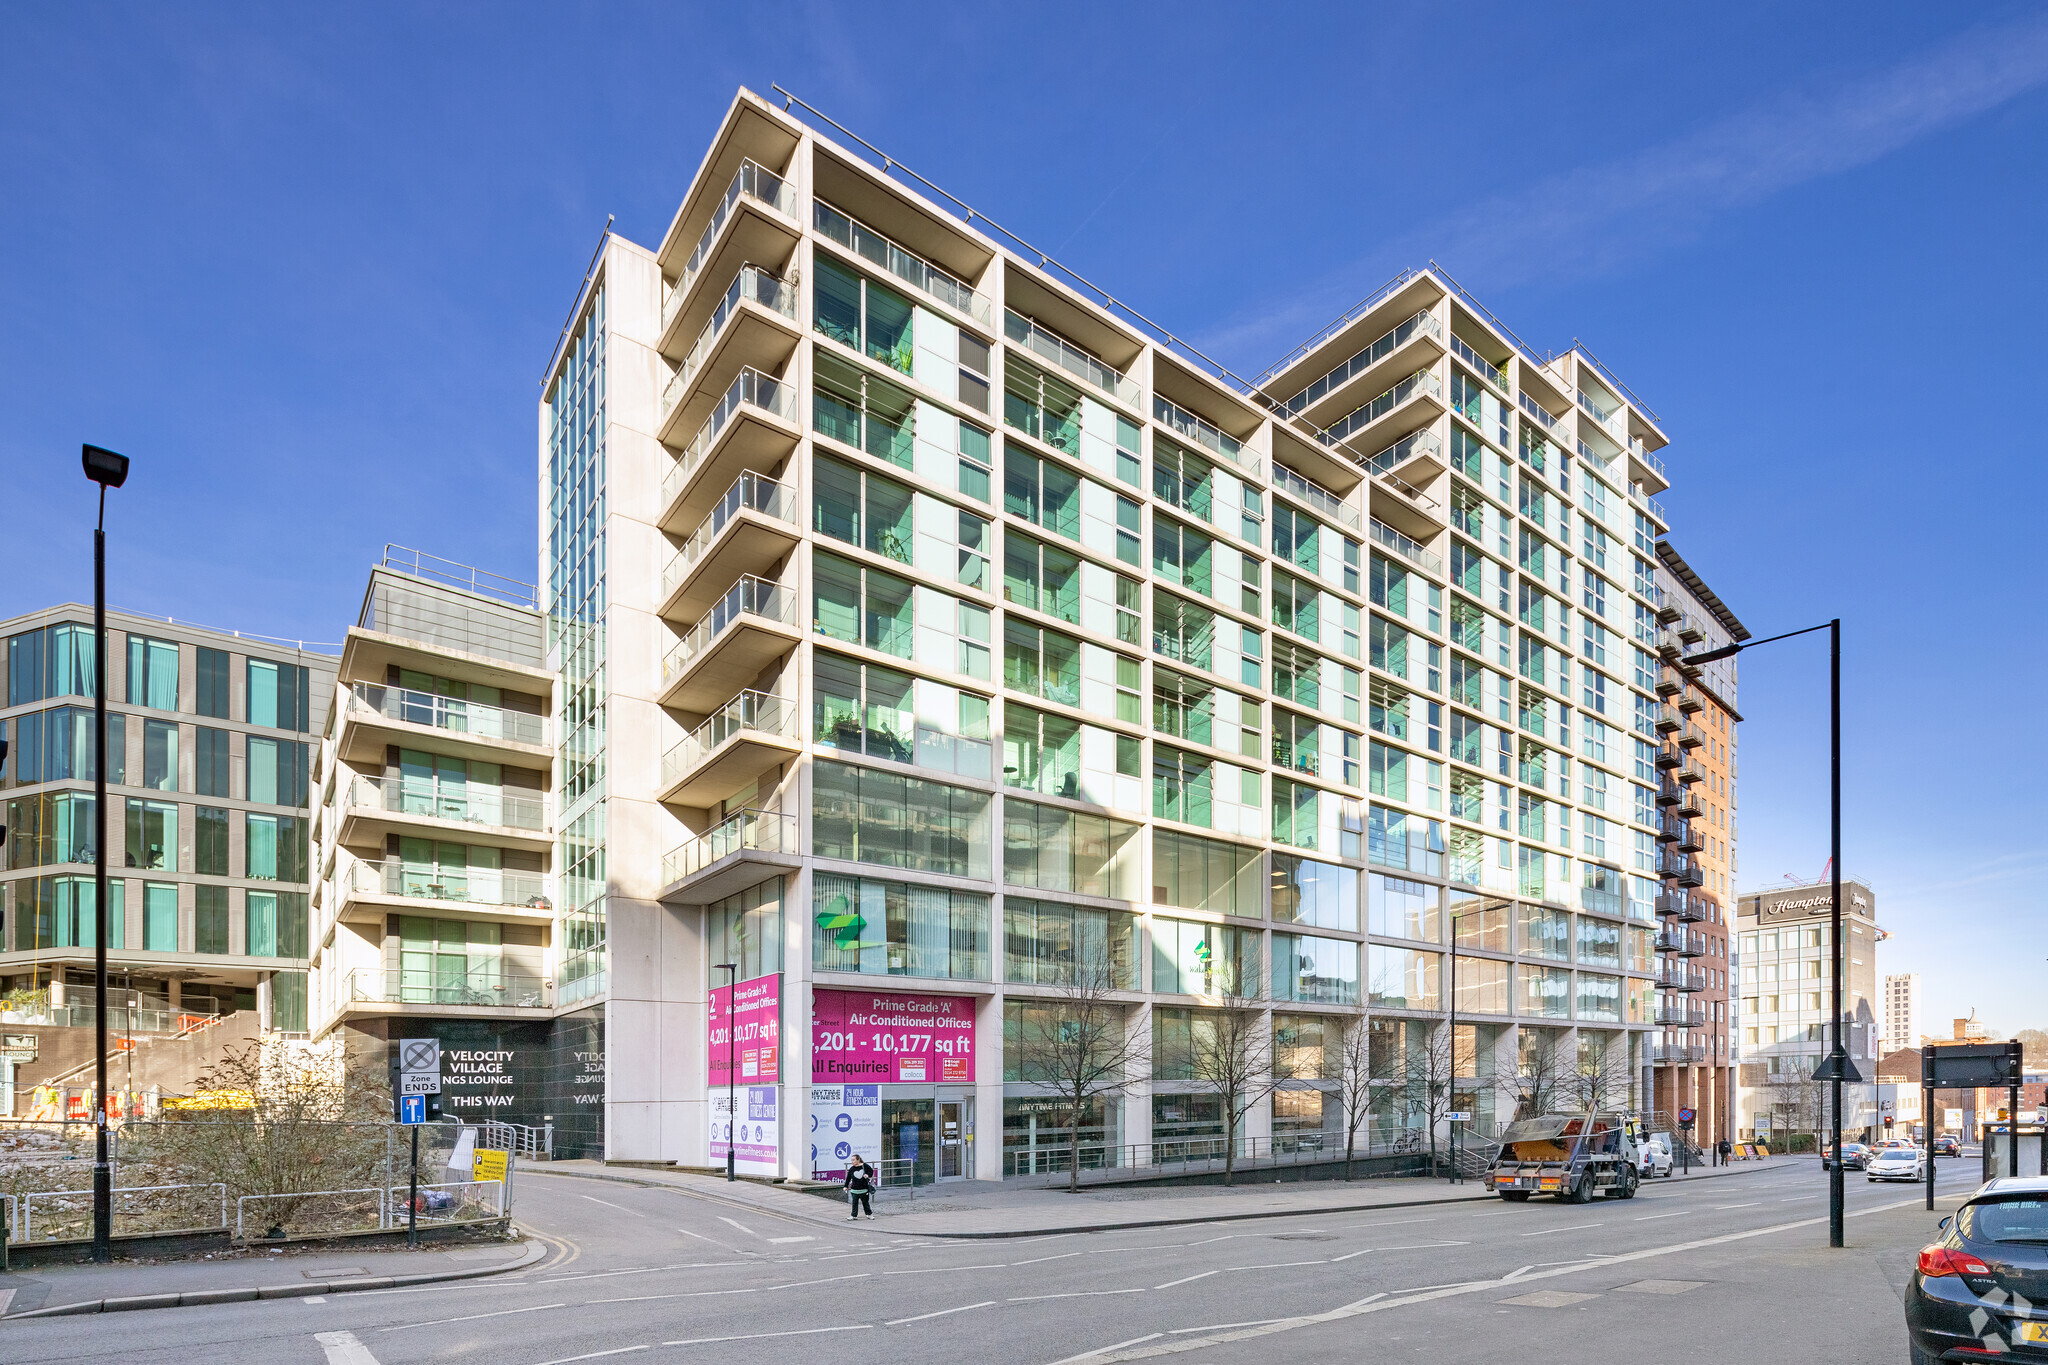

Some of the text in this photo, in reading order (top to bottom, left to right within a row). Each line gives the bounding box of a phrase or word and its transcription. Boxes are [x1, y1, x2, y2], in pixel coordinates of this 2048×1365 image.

[734, 990, 746, 1001] Prime
[747, 986, 762, 998] Grade
[710, 994, 716, 1013] 2
[760, 997, 777, 1008] Offices
[873, 999, 905, 1011] Prime
[907, 1000, 938, 1012] Grade
[850, 1013, 972, 1028] Air Conditioned Offices
[710, 1028, 729, 1047] 4,201
[734, 1022, 758, 1043] 10,177
[760, 1024, 768, 1040] sq
[770, 1019, 776, 1036] ft
[812, 1032, 856, 1053] ,201
[872, 1033, 931, 1054] 10,177
[935, 1039, 953, 1056] sq
[956, 1035, 970, 1052] ft
[450, 1051, 514, 1061] VELOCITY
[450, 1063, 503, 1073] VILLAGE
[828, 1060, 889, 1075] Enquiries
[443, 1075, 513, 1084] NGS LOUNGE
[853, 1088, 864, 1096] HOUR
[452, 1096, 514, 1106] THIS WAY
[846, 1096, 878, 1105] FITNESS CENTRE
